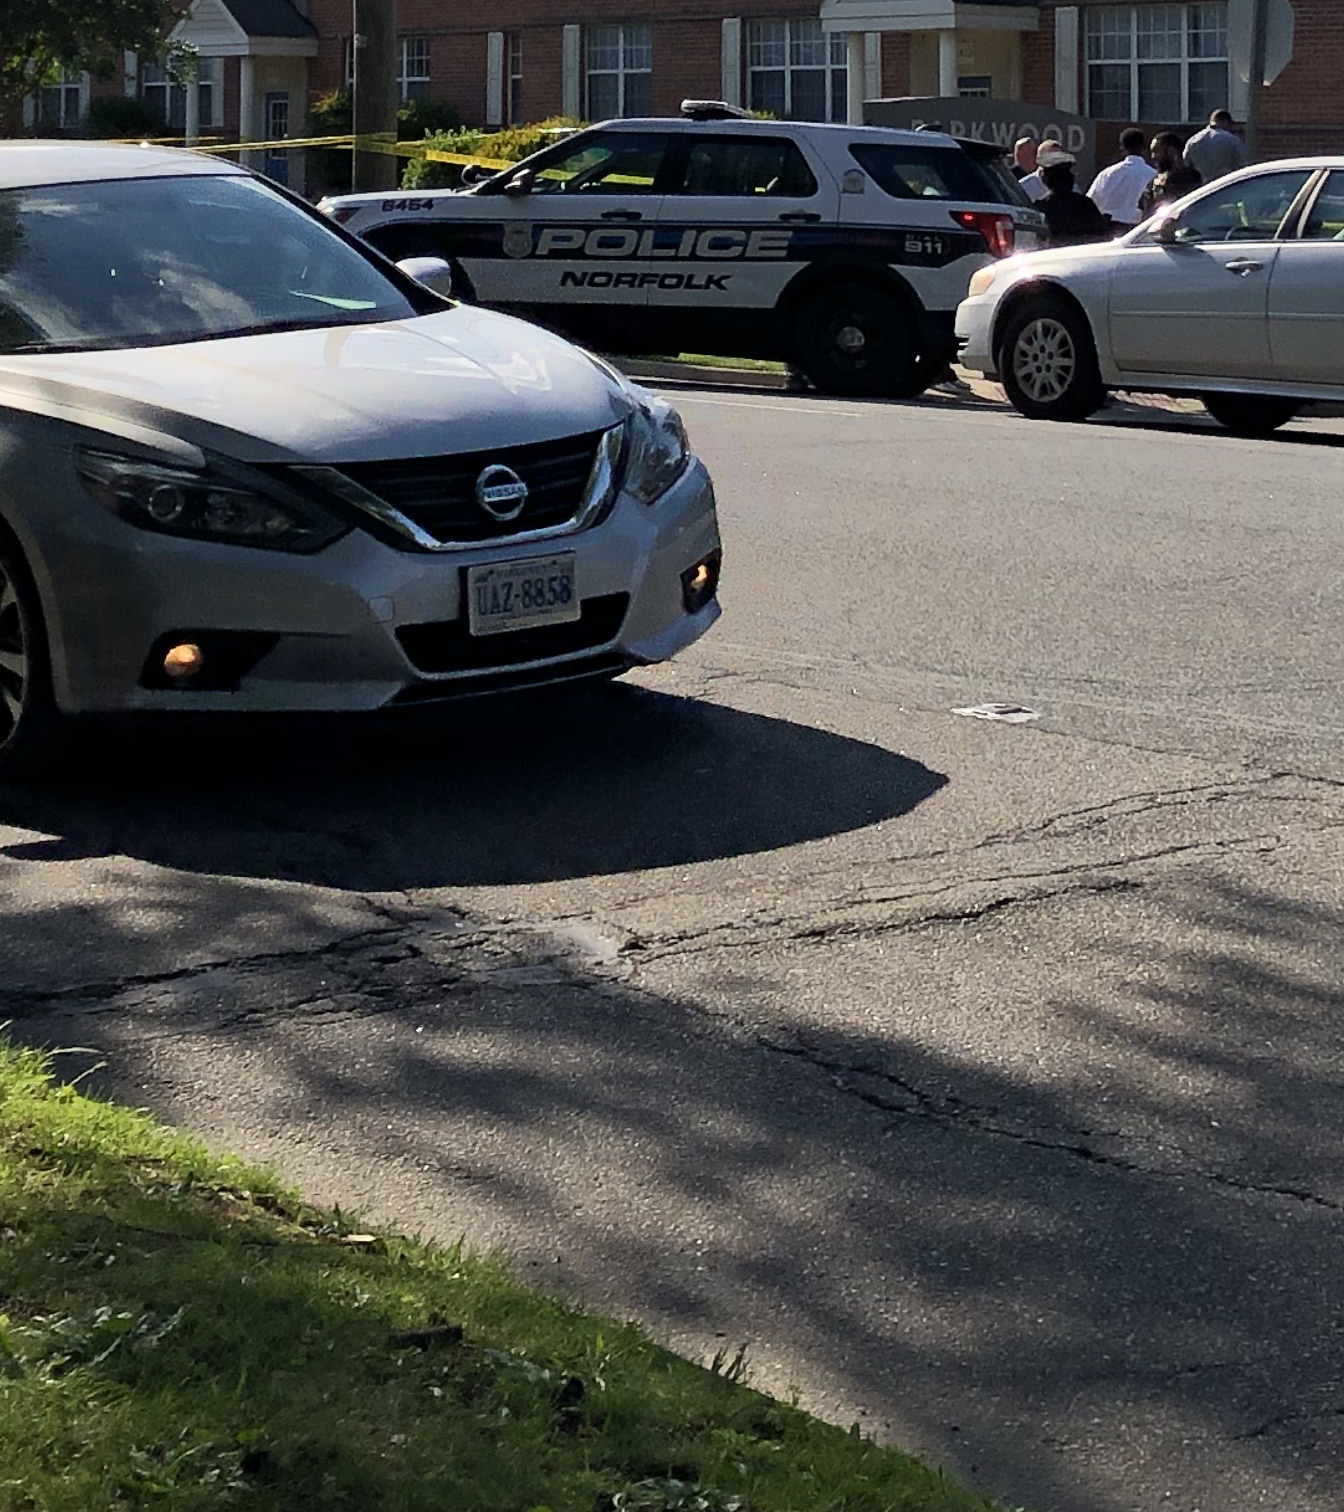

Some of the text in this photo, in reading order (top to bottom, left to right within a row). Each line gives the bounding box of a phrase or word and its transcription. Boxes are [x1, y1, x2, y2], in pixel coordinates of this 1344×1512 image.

[911, 118, 1085, 152] RKWOOD
[535, 228, 794, 258] POLICE
[905, 240, 943, 255] 911
[559, 271, 732, 290] NORFOLK
